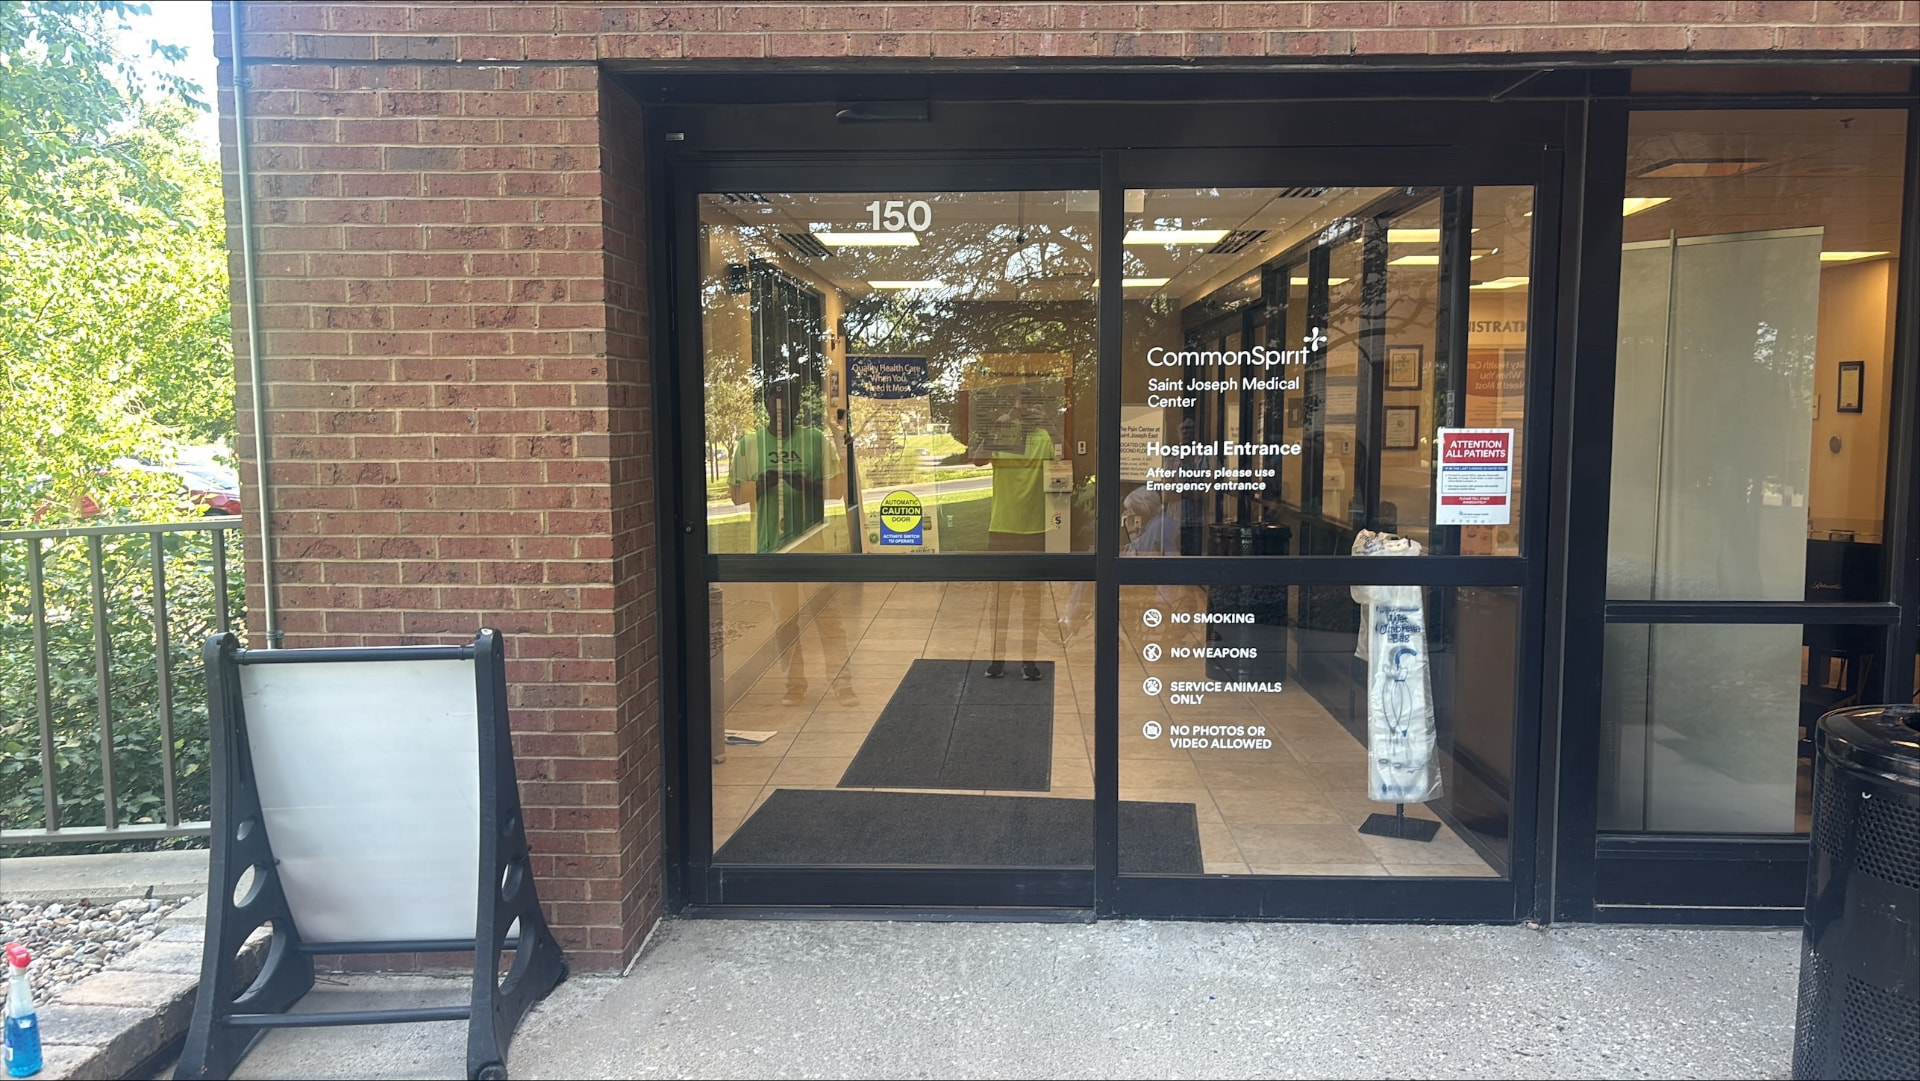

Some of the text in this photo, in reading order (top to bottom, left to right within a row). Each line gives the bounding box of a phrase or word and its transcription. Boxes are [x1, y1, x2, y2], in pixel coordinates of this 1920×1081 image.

[866, 201, 932, 231] 150
[1146, 345, 1310, 370] CommonSpirit
[852, 363, 921, 374] Quality Health Care
[870, 374, 906, 382] When You
[1148, 376, 1300, 394] Saint Joseph Medical
[1147, 394, 1197, 408] Center
[1130, 432, 1148, 440] Joseph
[1450, 440, 1502, 448] ATTENTION
[1146, 441, 1302, 459] Hospital Entrance
[1445, 450, 1506, 458] ALL PATIENTS
[1146, 467, 1177, 478] After
[1178, 467, 1212, 478] hours
[1214, 467, 1252, 480] please
[1254, 468, 1276, 478] use
[1146, 481, 1266, 493] Emergency entrance
[882, 507, 921, 515] CAUTION
[1170, 613, 1255, 624] NO SMOKING
[1170, 648, 1258, 658] NO WEAPONS
[1170, 682, 1282, 693] SERVICE ANIMALS
[1170, 694, 1204, 704] ONLY
[1170, 726, 1266, 736] NO PHOTOS OR
[1170, 738, 1272, 749] VIDEO ALLOWED
